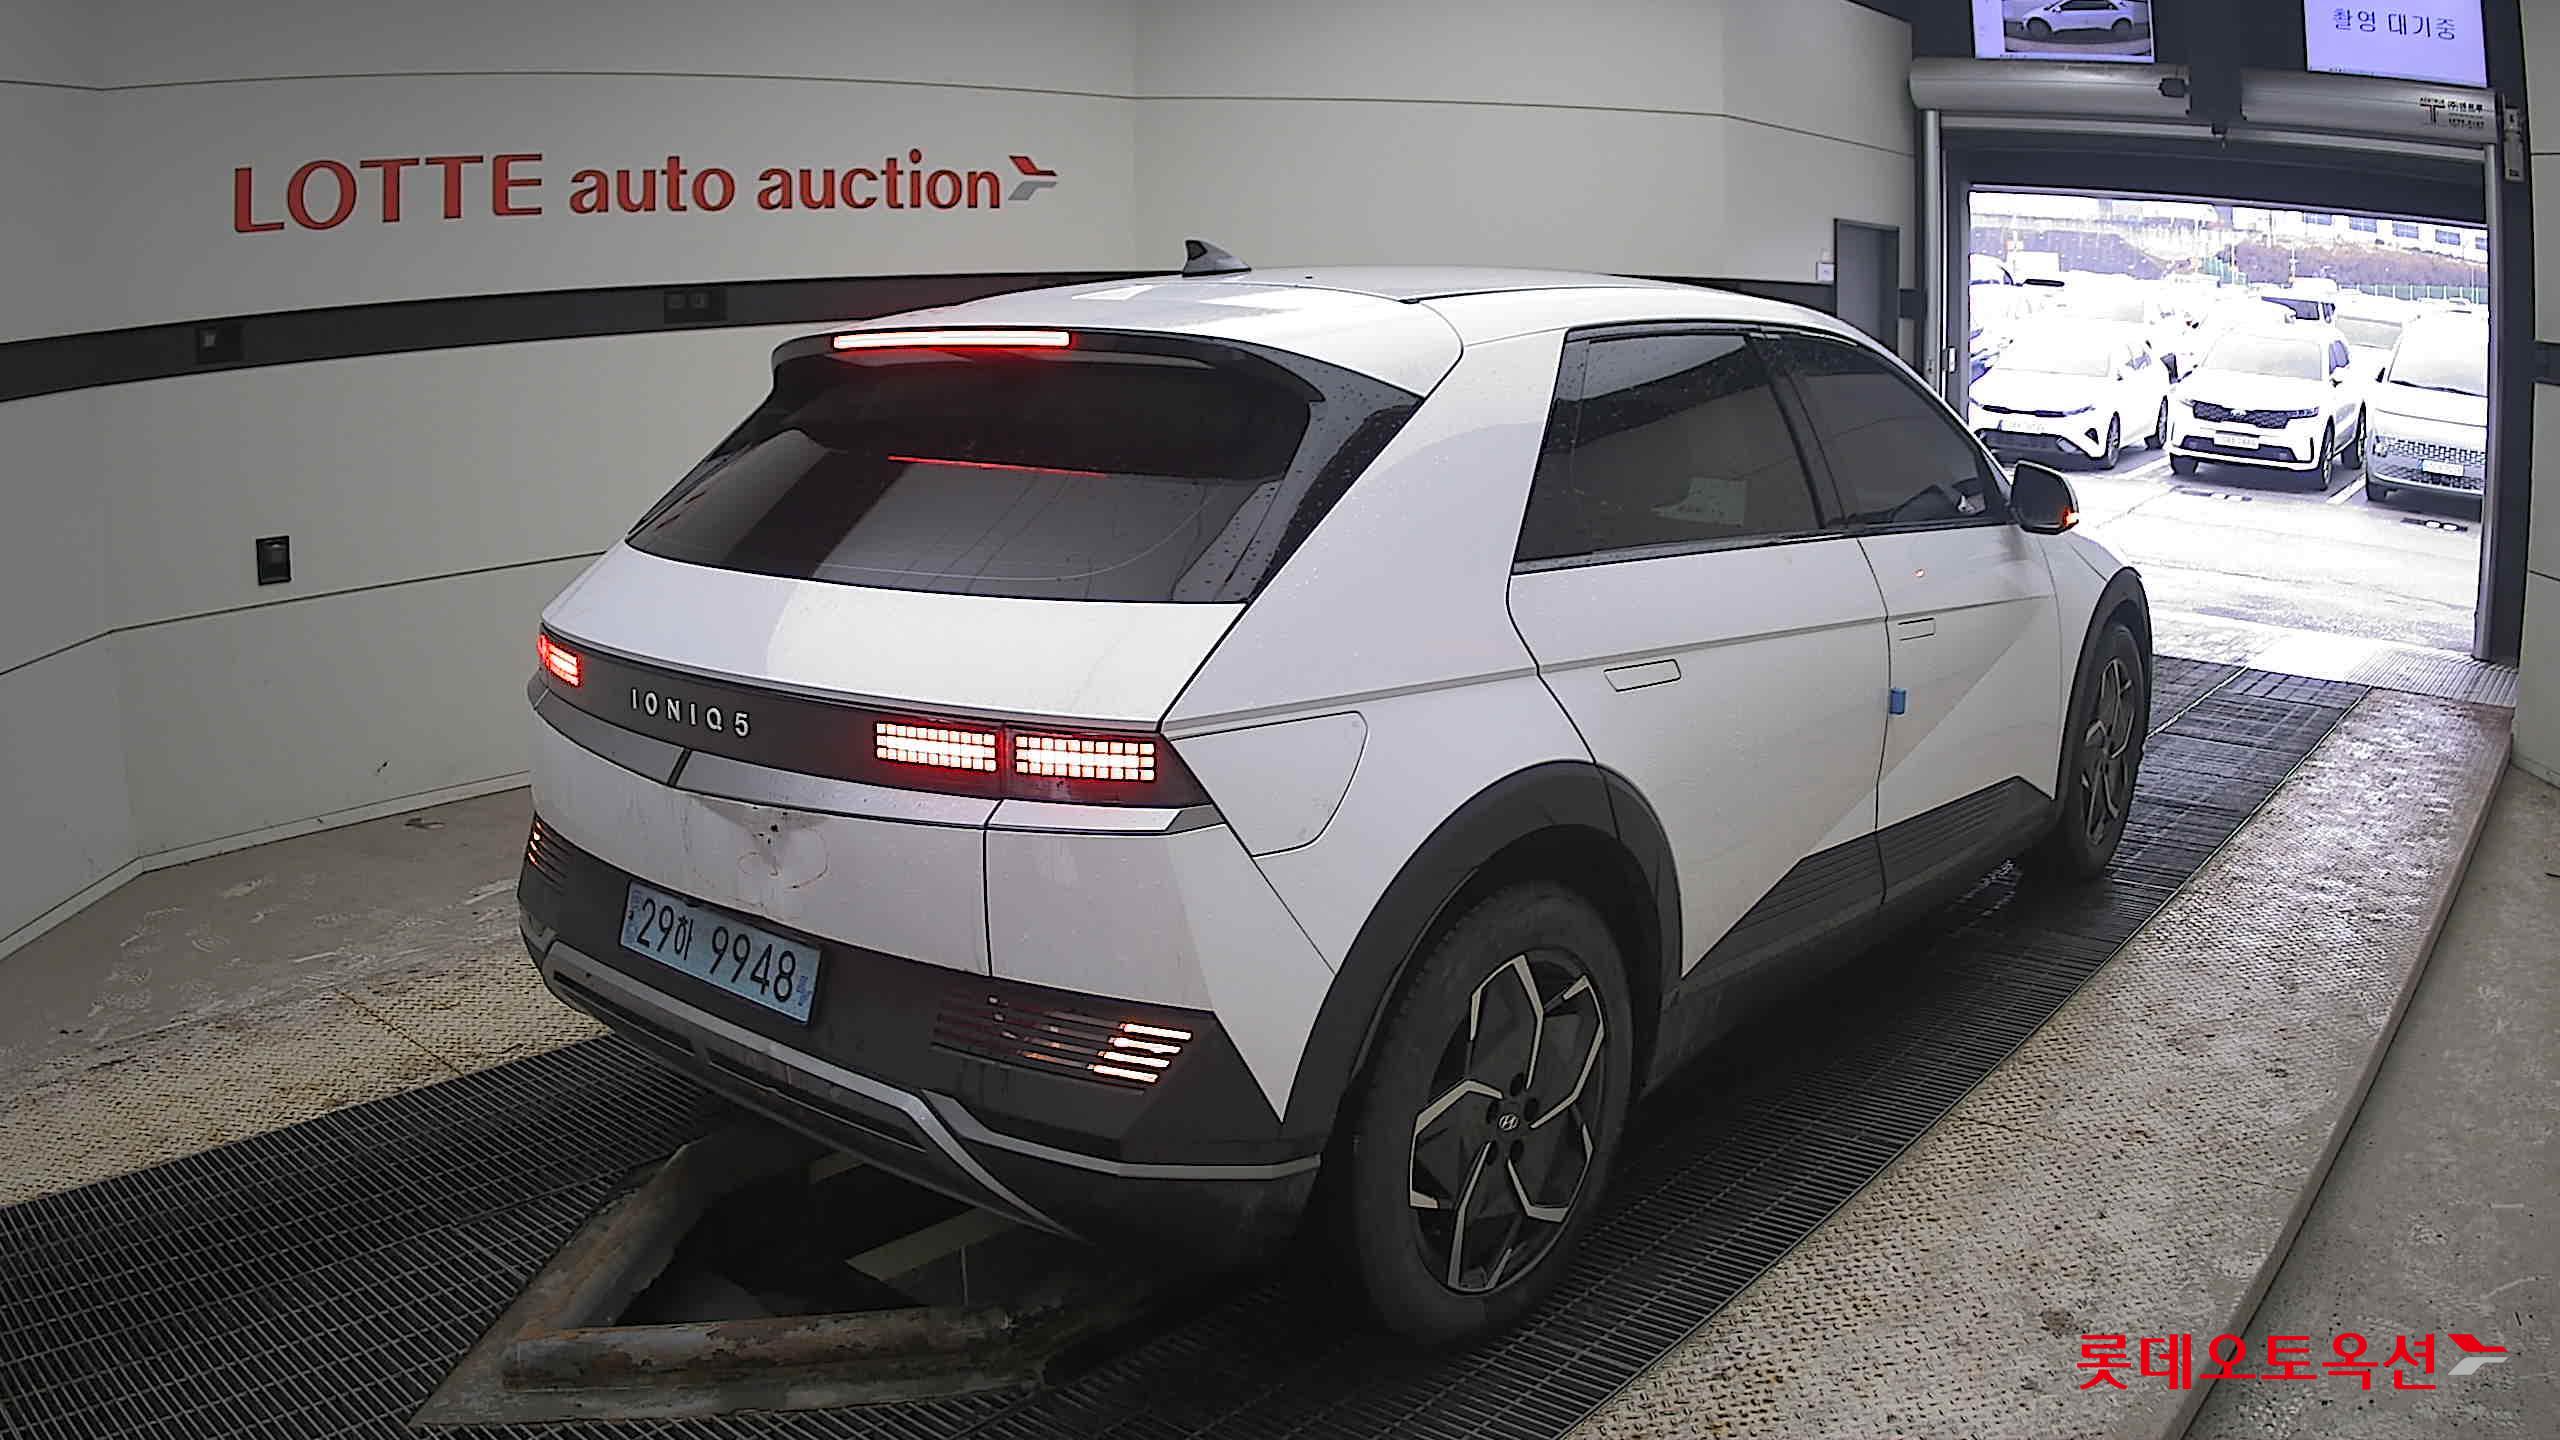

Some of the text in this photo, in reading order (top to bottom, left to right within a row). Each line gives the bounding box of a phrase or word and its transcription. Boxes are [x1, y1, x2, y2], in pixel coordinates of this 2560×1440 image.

[2333, 8, 2456, 41] 촬영 대기중
[234, 147, 1001, 233] LOTTE auto auction
[630, 687, 750, 738] IONIQ 5
[636, 898, 796, 1003] 29하 9948
